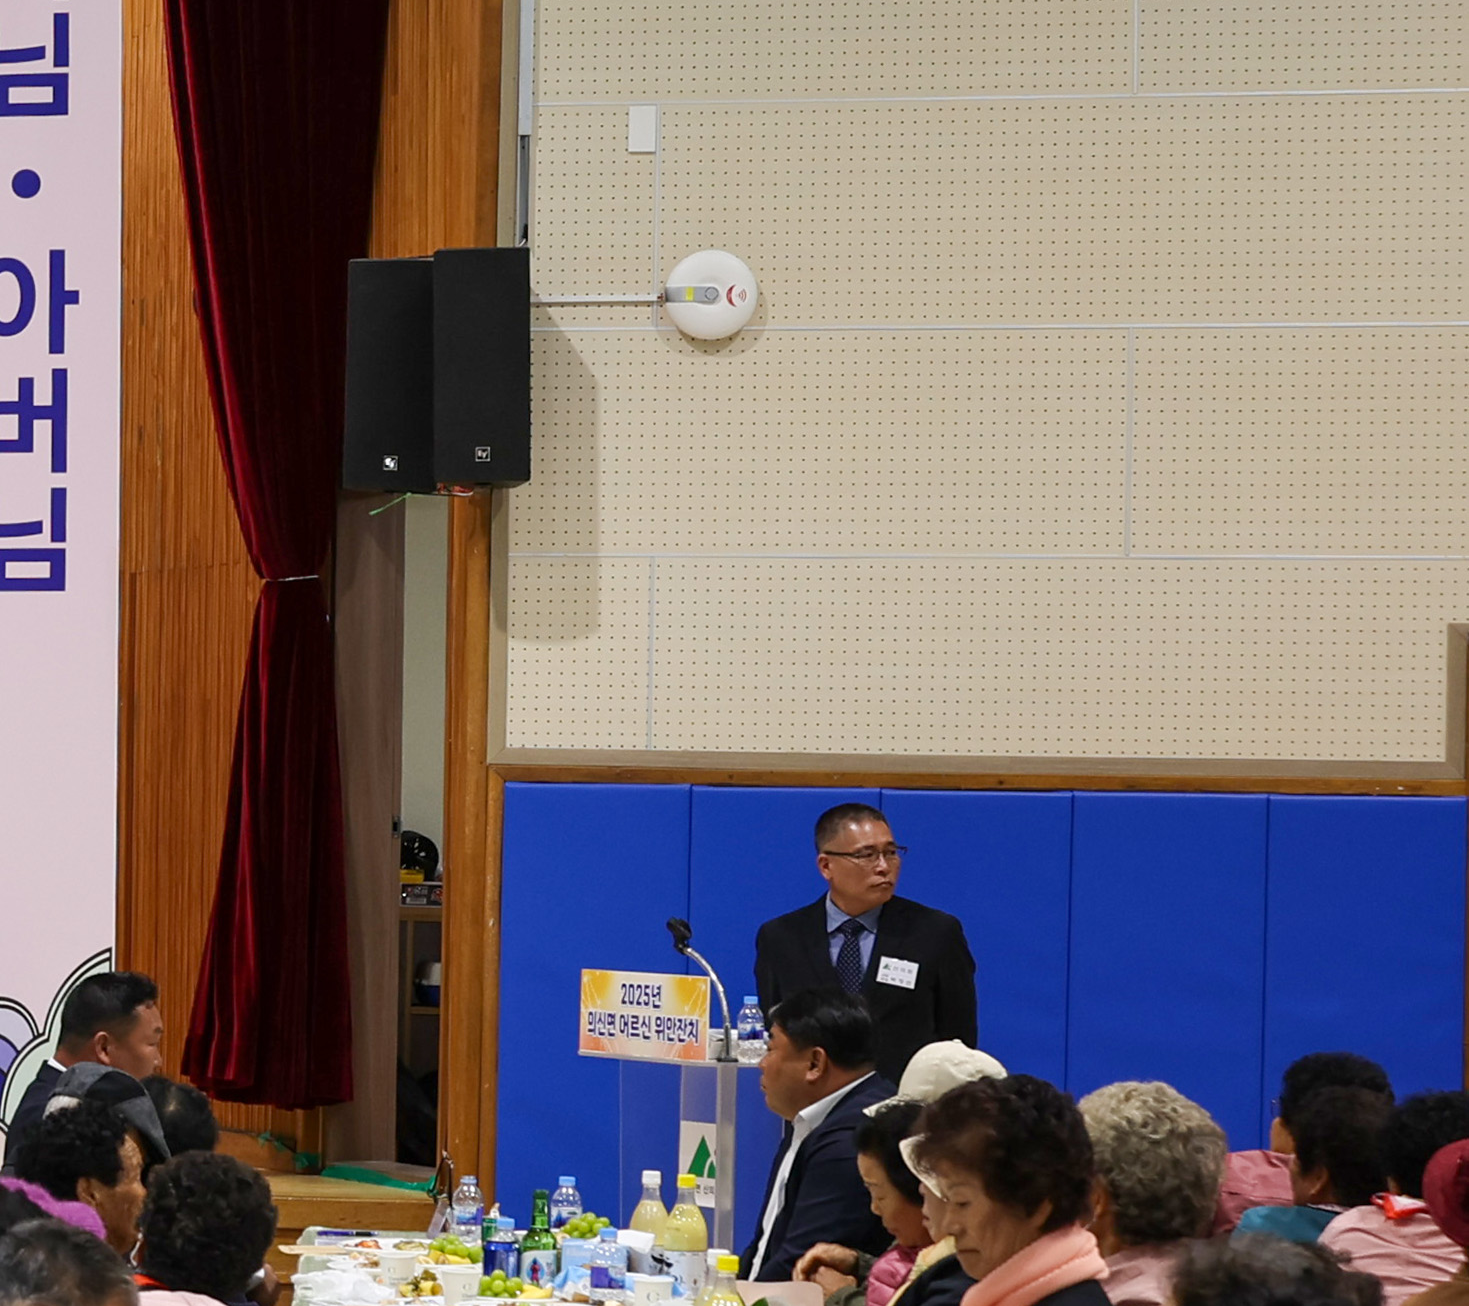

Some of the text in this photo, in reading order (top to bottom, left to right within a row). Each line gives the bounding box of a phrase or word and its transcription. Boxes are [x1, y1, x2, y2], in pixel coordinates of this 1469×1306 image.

[620, 983, 663, 1009] 2025년
[587, 1011, 699, 1044] 의신면 어르신 위안잔치
